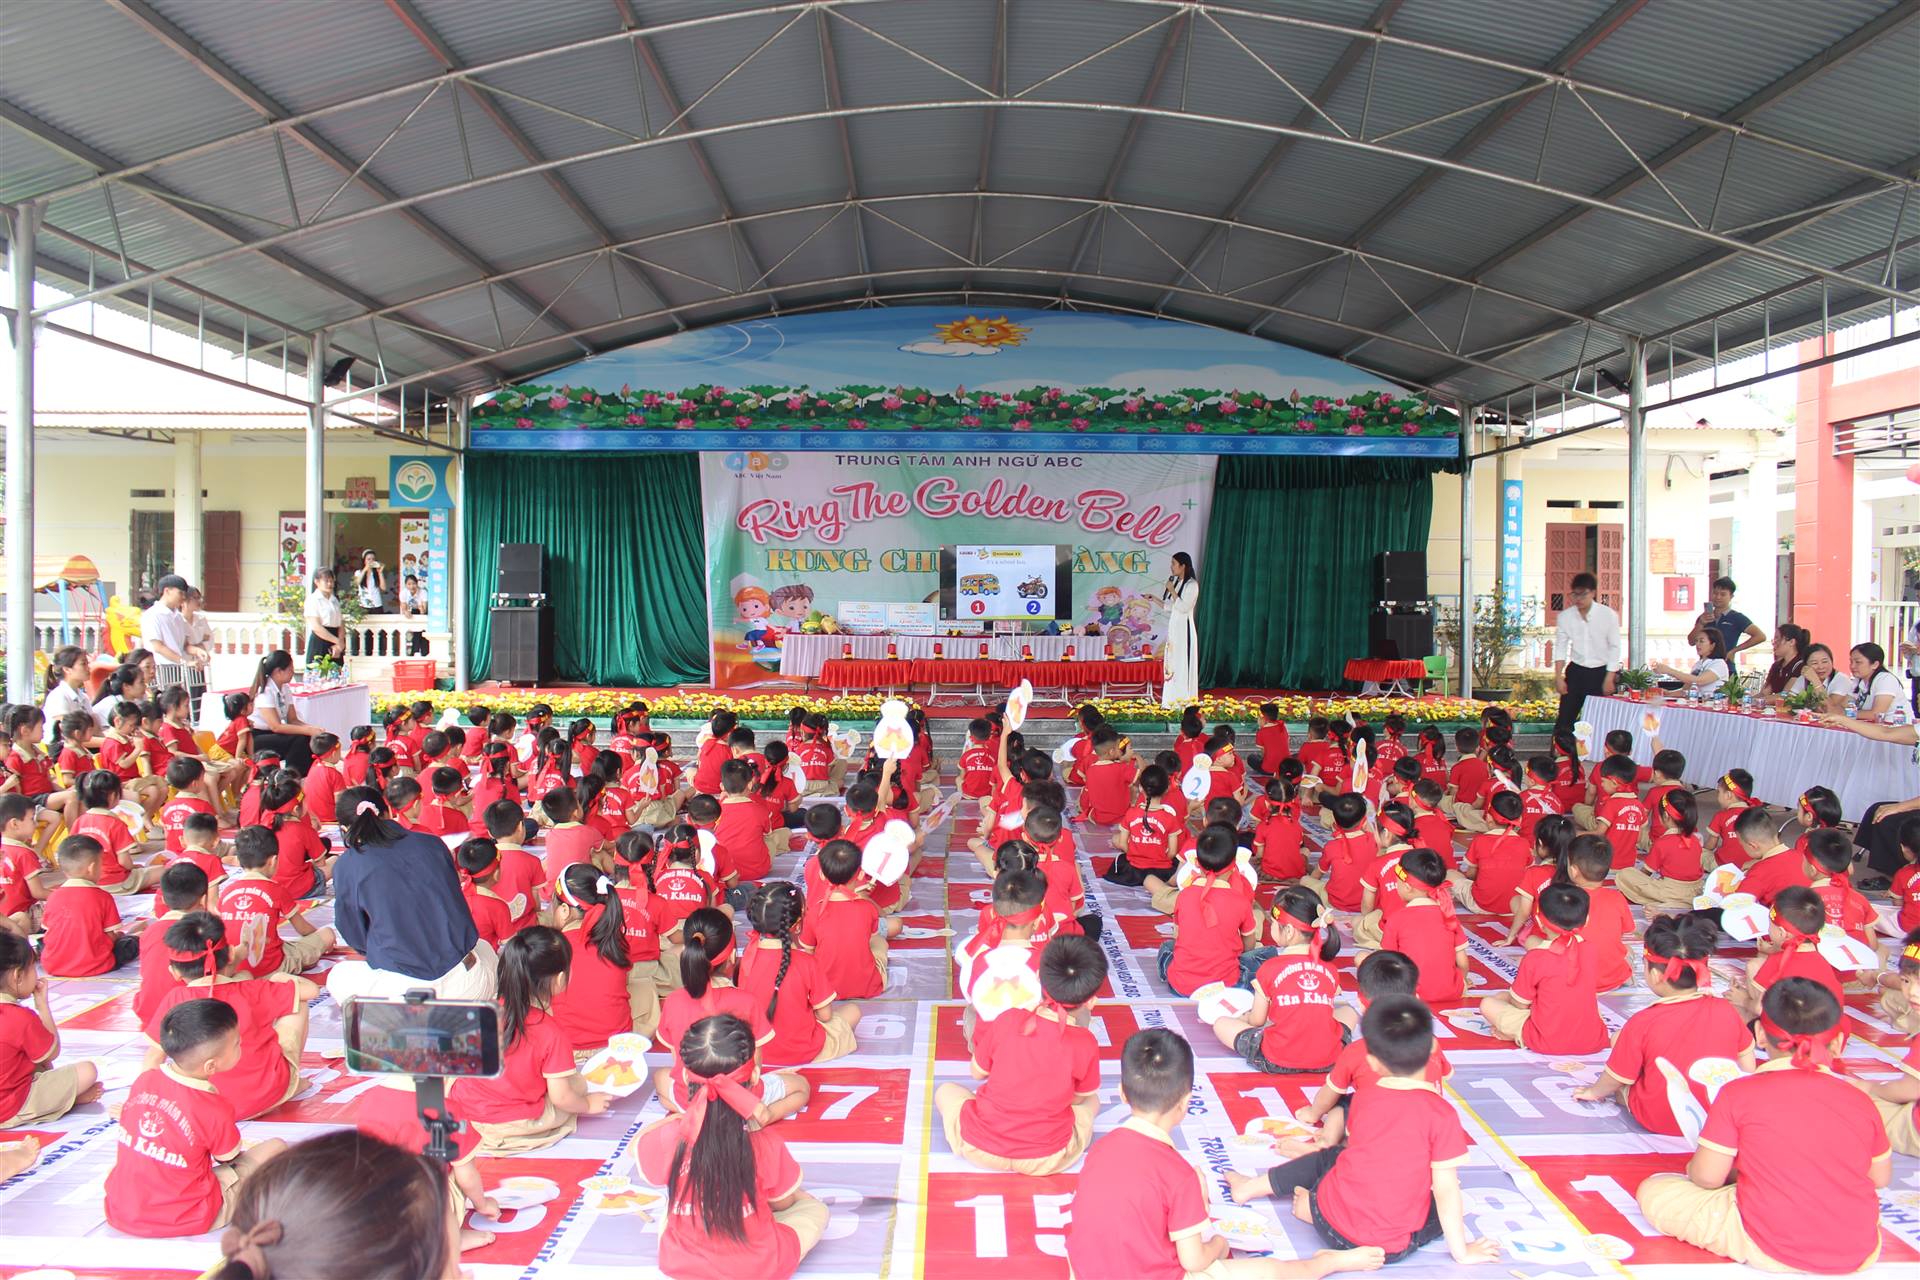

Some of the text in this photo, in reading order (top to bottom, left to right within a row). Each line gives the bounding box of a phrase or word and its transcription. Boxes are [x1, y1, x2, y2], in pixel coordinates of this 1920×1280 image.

[835, 453, 1083, 467] TRUNG TÂM ANH NGỮ ABC
[737, 478, 1182, 546] Ring The Golden Bell
[766, 545, 1151, 574] RUNG CH ÀNG
[1189, 776, 1202, 797] 2
[877, 851, 892, 875] 1
[671, 891, 703, 903] Khánh
[1741, 915, 1761, 935] 1
[1837, 945, 1861, 965] 1
[1217, 998, 1239, 1015] 1
[1277, 994, 1300, 1006] Tân
[854, 1014, 907, 1040] 6
[1198, 1136, 1237, 1175] TRUNG
[954, 1190, 1077, 1258] 15
[1511, 1240, 1566, 1253] 2
